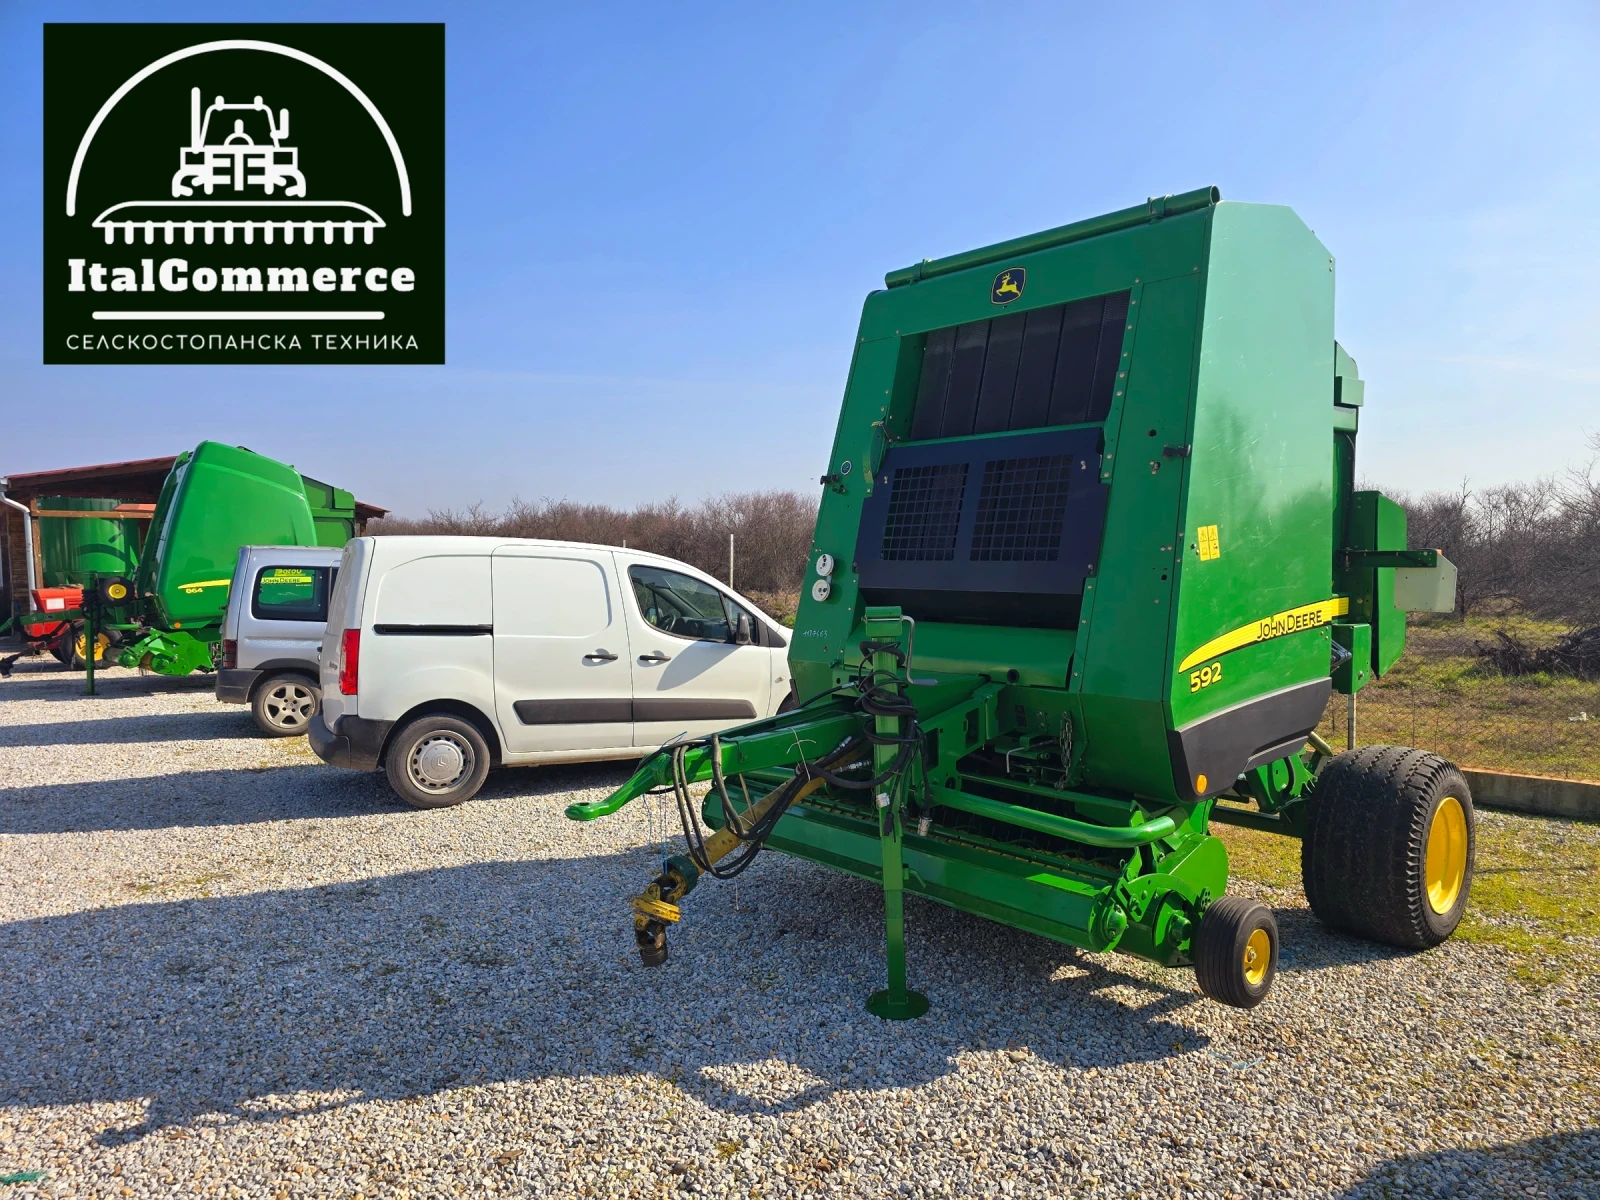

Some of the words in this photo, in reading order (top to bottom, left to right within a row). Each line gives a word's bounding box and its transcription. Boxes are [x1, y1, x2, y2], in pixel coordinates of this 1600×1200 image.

[1256, 618, 1286, 640] JOHN
[1287, 610, 1323, 631] DEERE
[1189, 660, 1223, 693] 592
